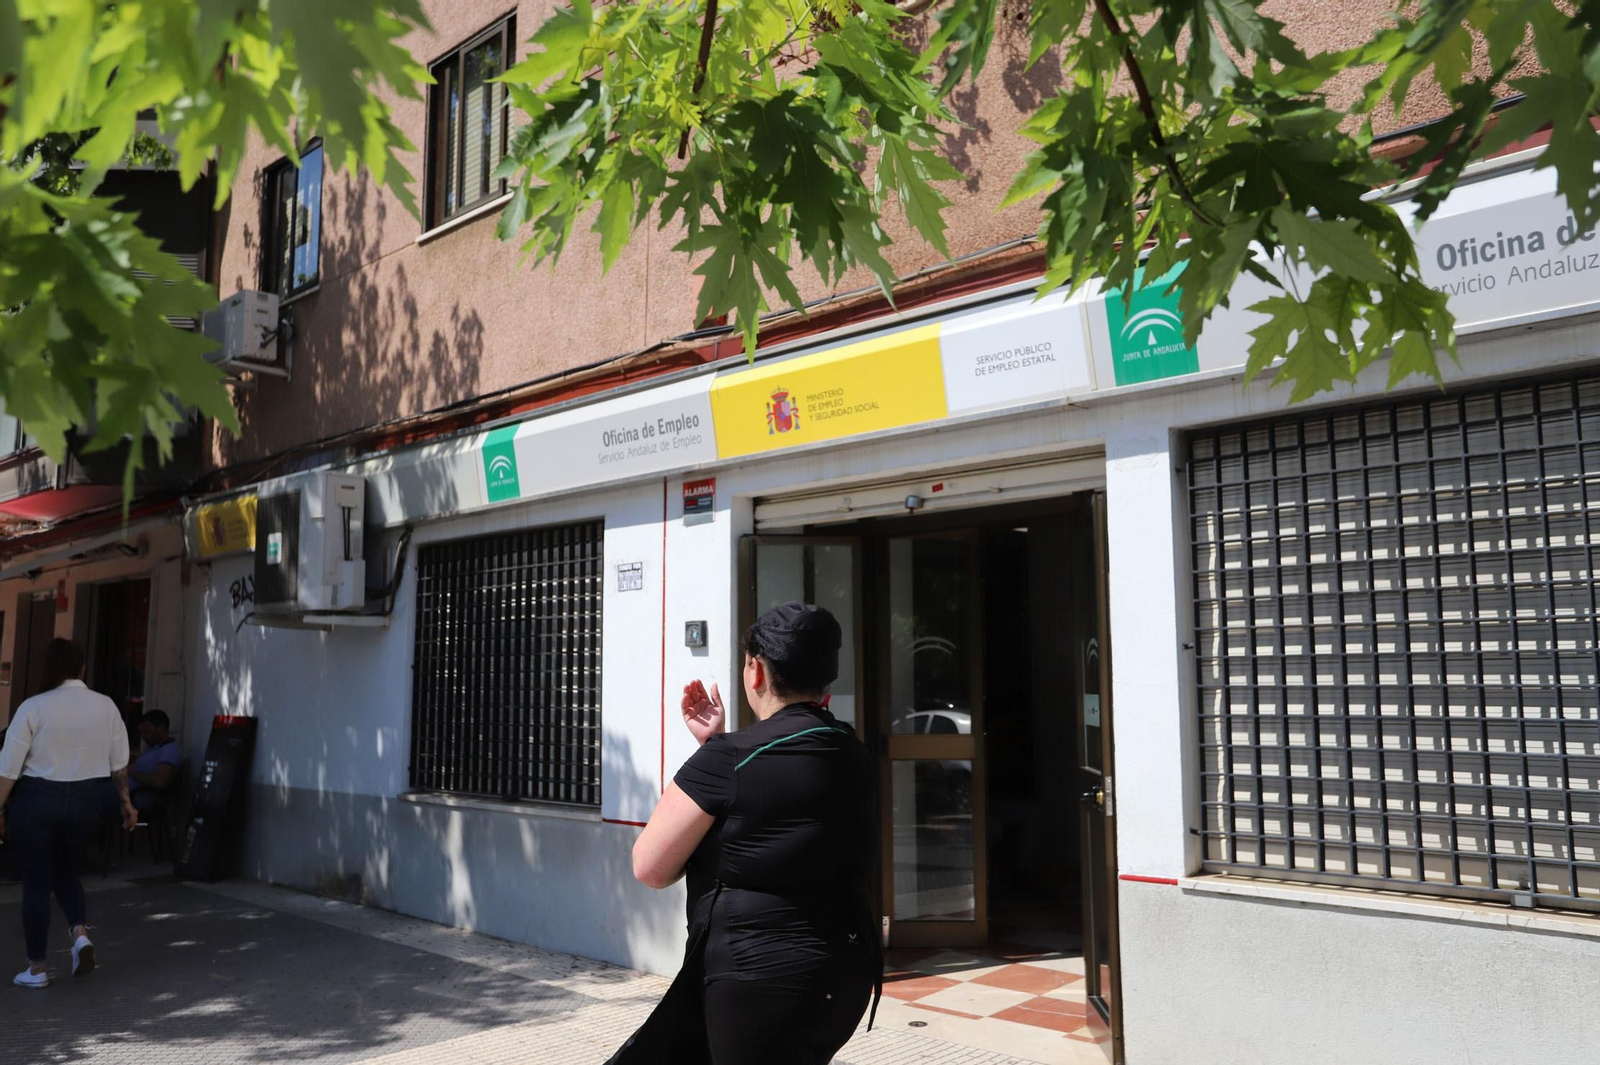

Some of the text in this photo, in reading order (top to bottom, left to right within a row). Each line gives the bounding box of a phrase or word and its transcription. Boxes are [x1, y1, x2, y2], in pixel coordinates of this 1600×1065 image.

[1436, 230, 1546, 271] Oficina
[1508, 253, 1600, 286] Andaluz
[976, 349, 1013, 366] SERVICIO
[1143, 348, 1151, 358] DE
[975, 353, 1057, 377] DE EMPLEO ESTATAL
[806, 387, 844, 402] MINISTERIO
[807, 398, 844, 413] DE EMPLEO
[815, 406, 853, 421] SEGURIDAD
[854, 401, 880, 413] SOCIAL
[602, 413, 700, 447] Oficina de Empleo
[598, 433, 702, 465] Servicio Andaluz de Empleo
[684, 485, 714, 498] ALARMA
